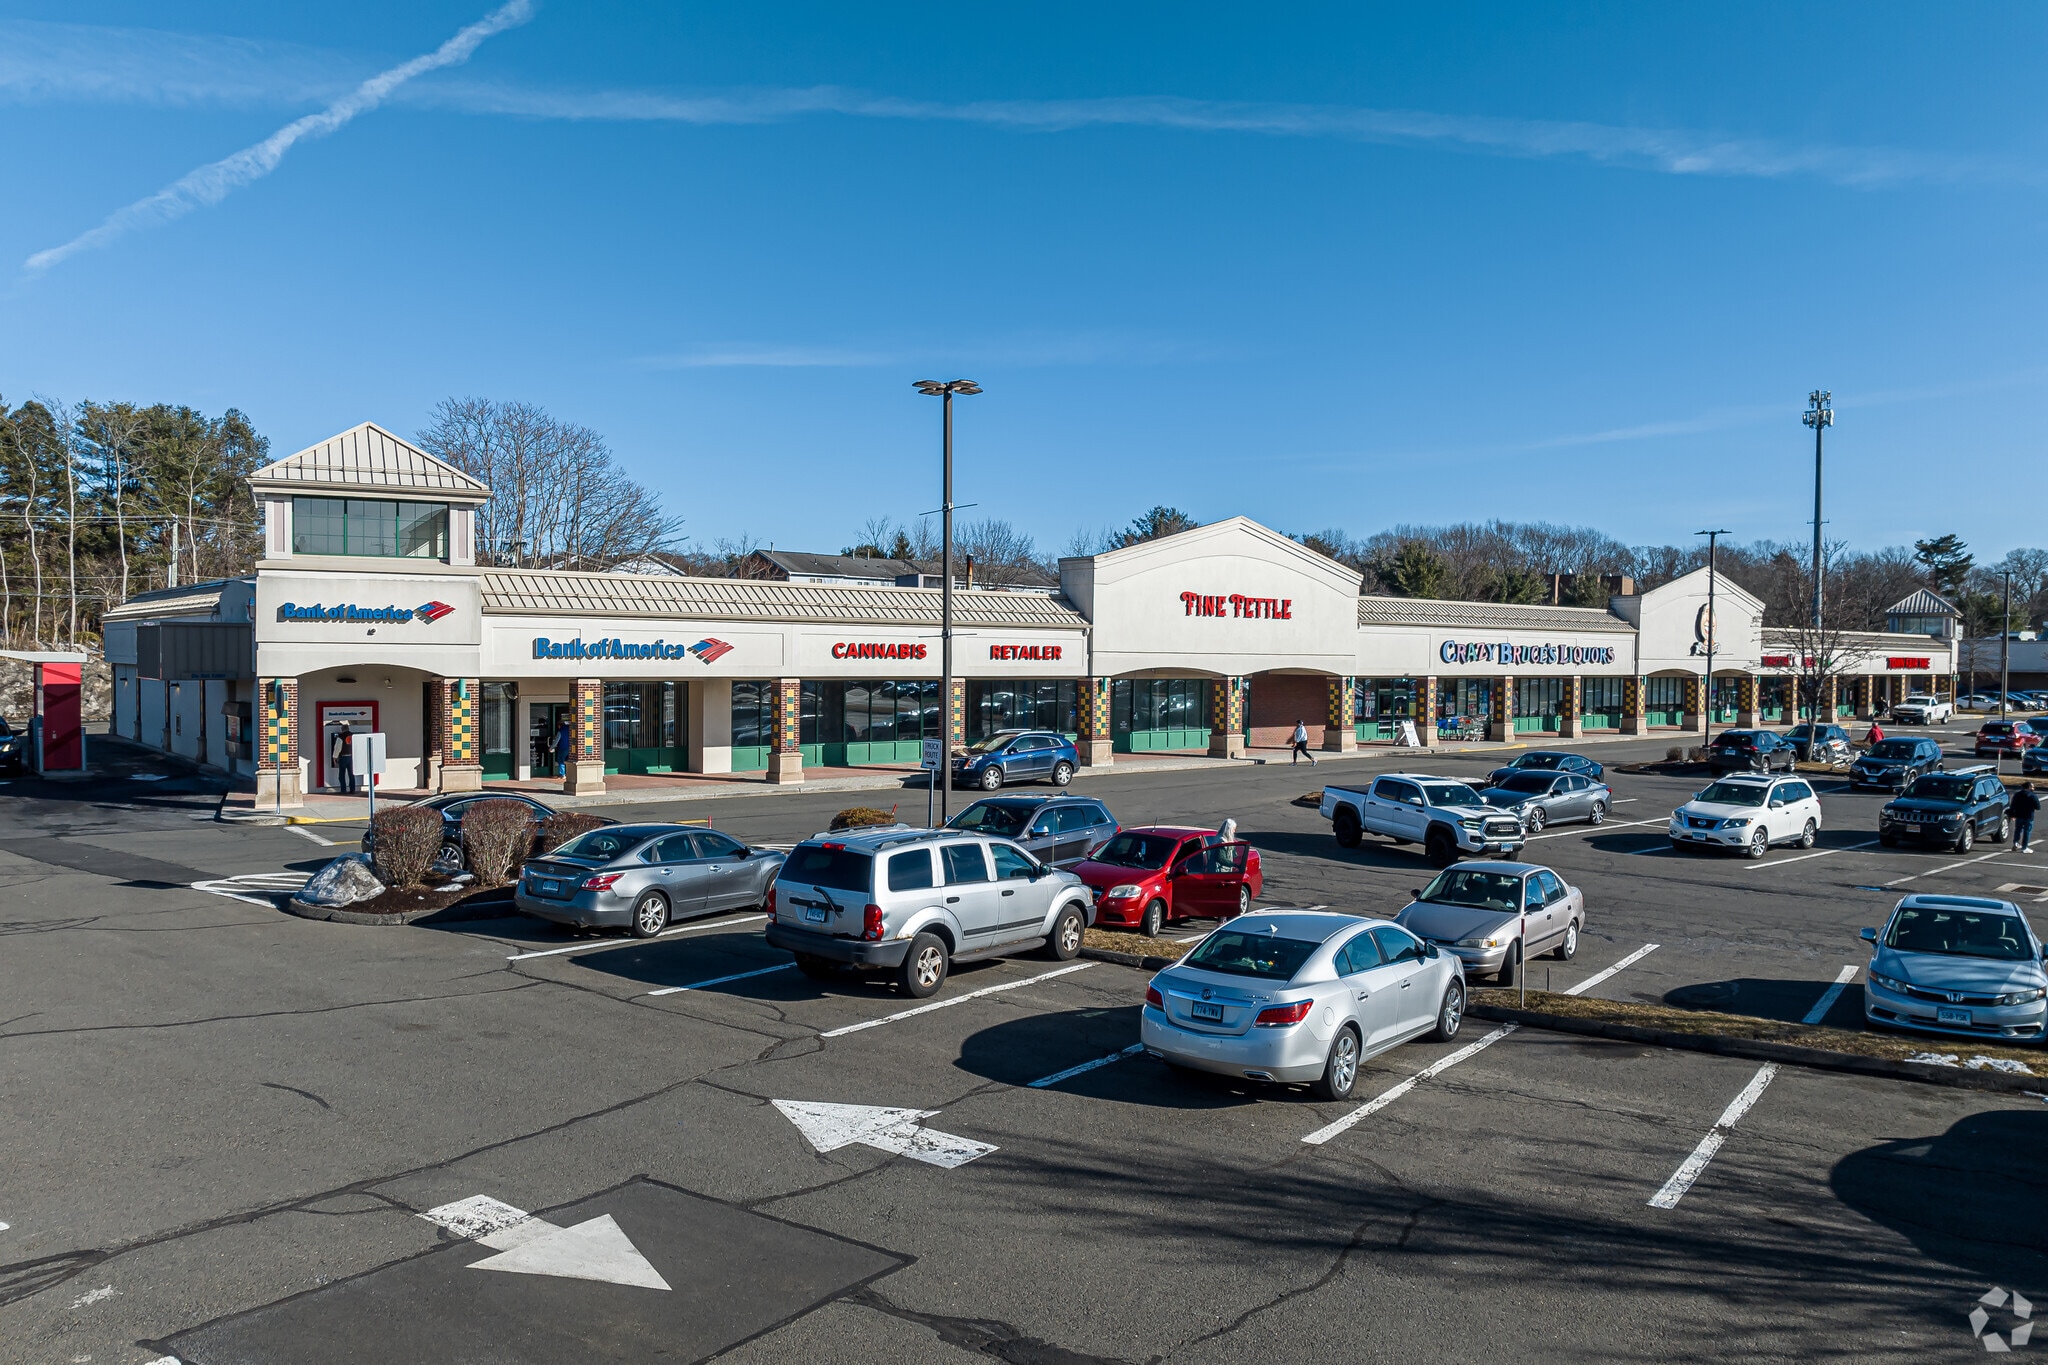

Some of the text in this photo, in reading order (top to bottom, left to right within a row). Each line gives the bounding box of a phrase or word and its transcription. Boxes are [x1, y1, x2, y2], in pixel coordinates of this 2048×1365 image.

[281, 602, 414, 621] Bank of America
[1180, 591, 1292, 619] FINE FETTLE
[536, 637, 686, 659] Bank of America
[832, 642, 1063, 661] CANNABIS RETAILER
[1440, 640, 1616, 665] CRAZY BRUCE'S LIQUORS
[924, 741, 939, 750] TRUCK
[924, 750, 939, 759] ROUTE
